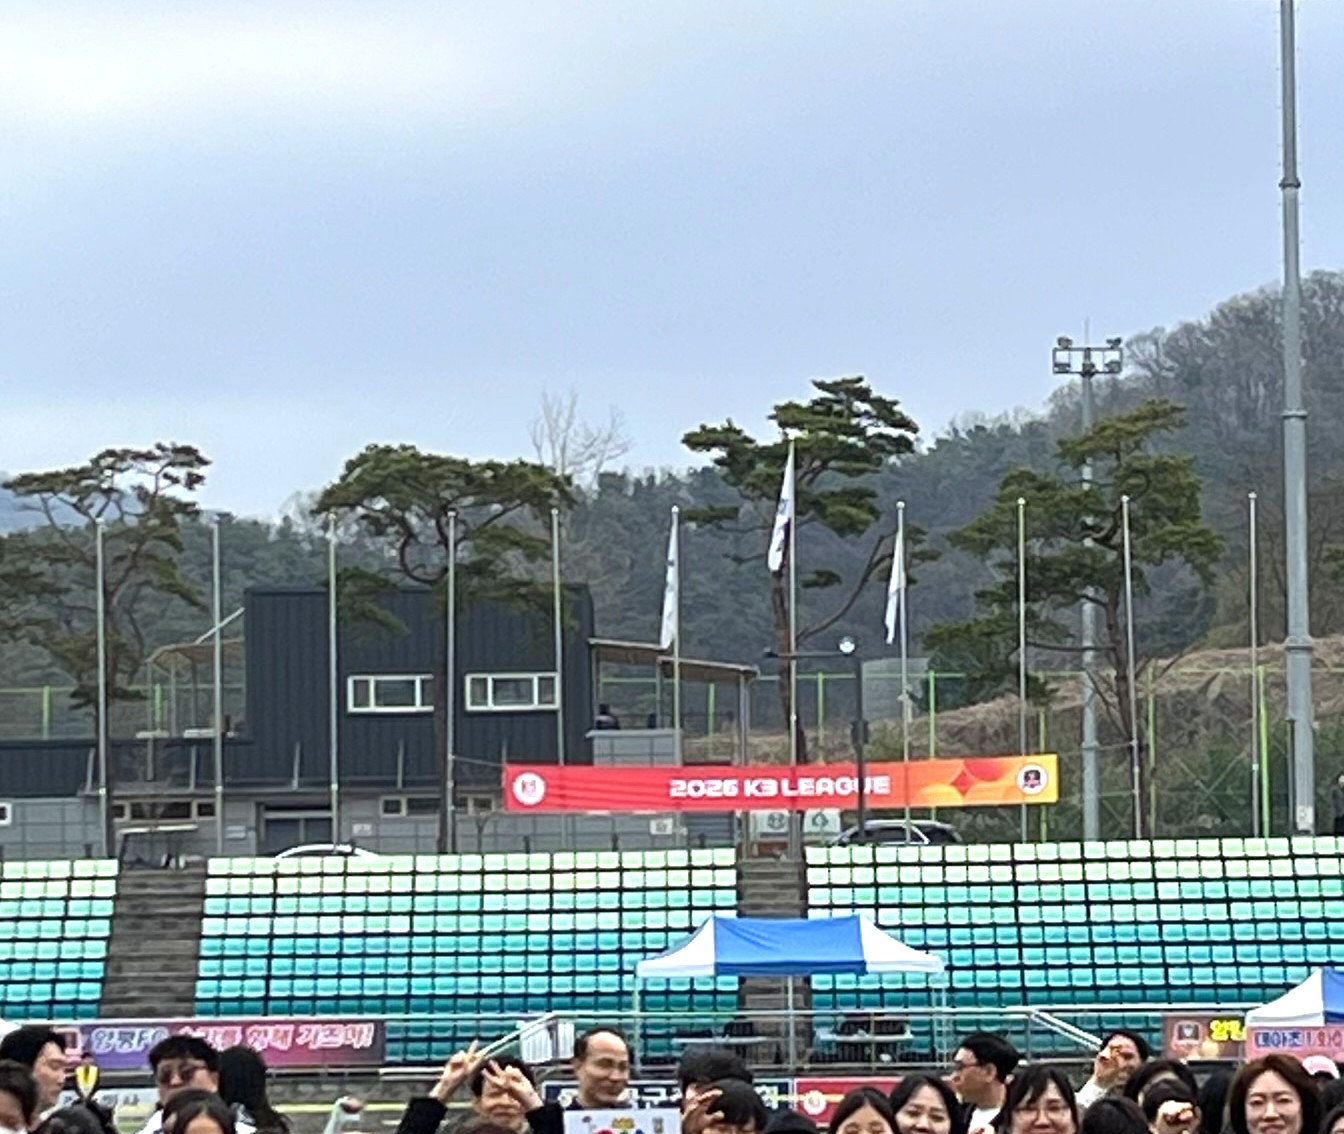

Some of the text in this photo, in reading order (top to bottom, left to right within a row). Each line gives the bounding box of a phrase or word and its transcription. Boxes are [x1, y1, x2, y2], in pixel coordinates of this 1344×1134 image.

[669, 774, 891, 798] 2026 K3 LEAGUE
